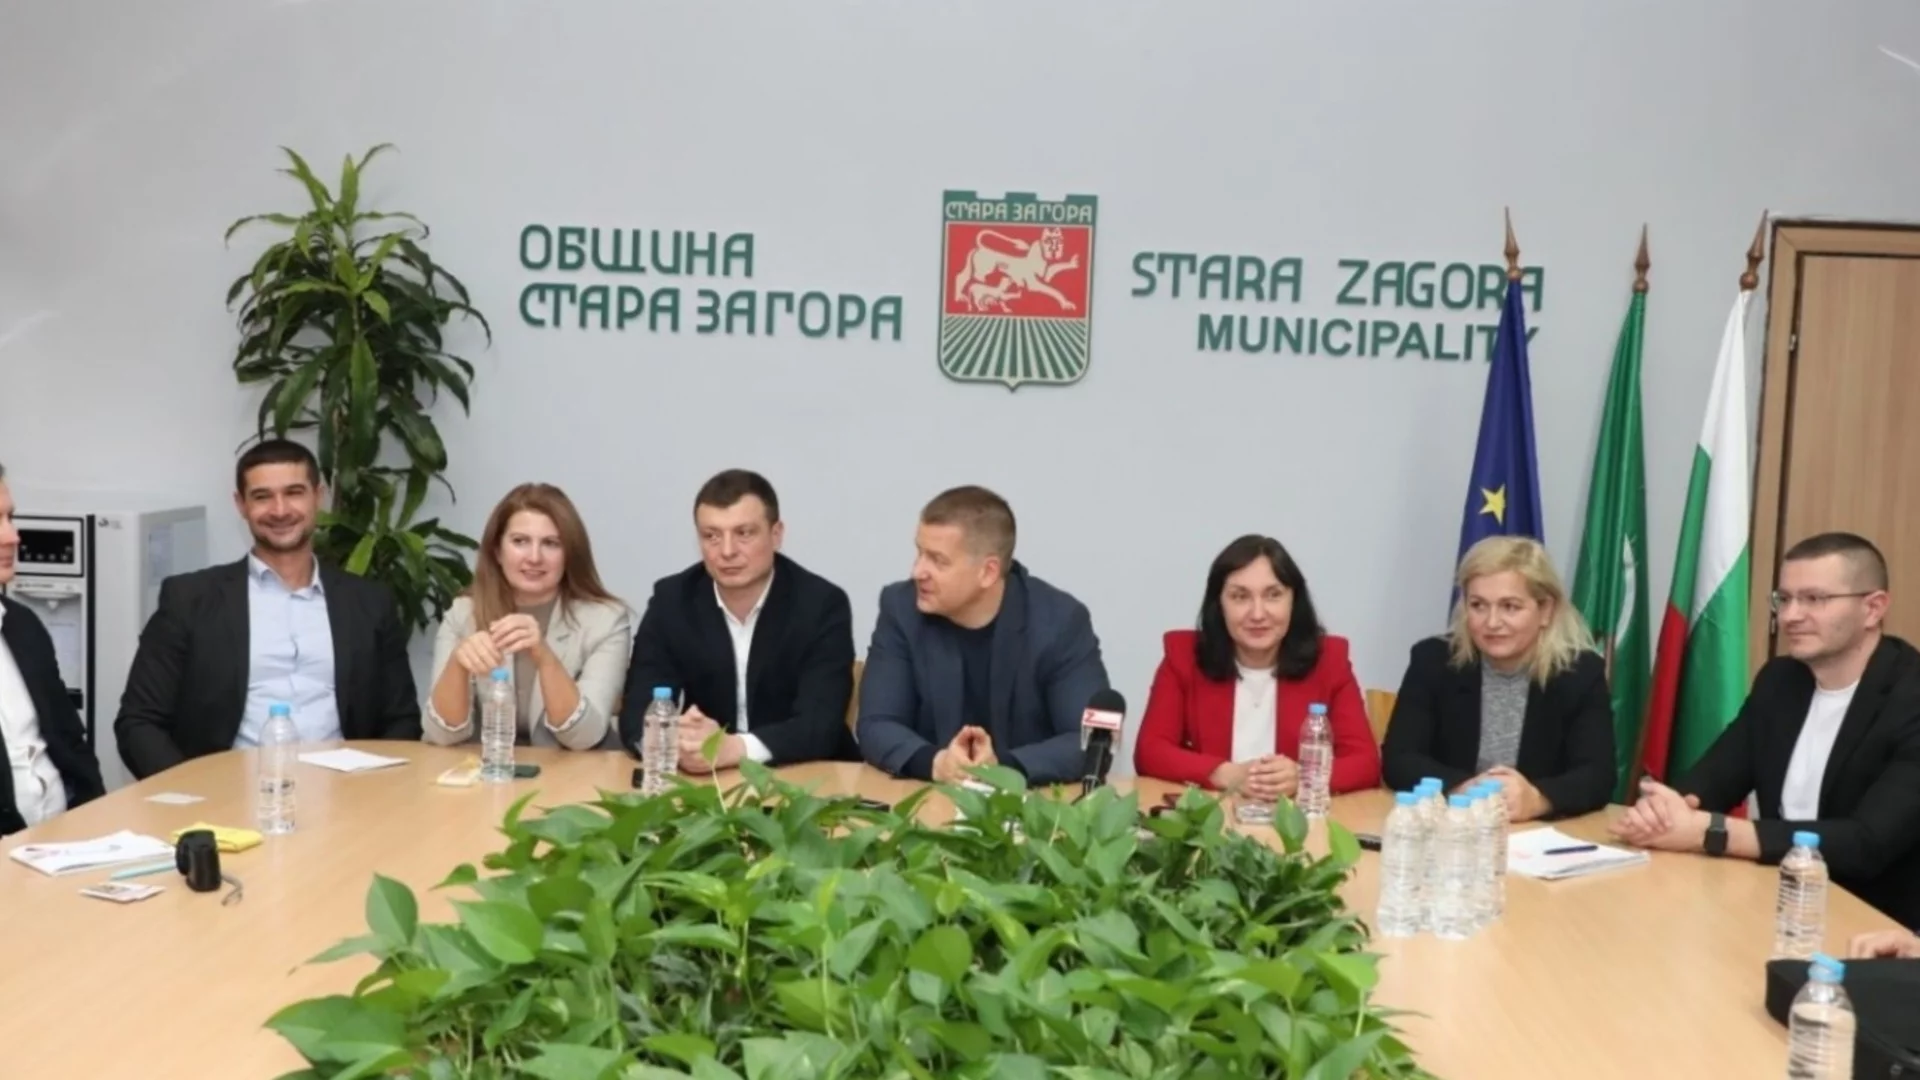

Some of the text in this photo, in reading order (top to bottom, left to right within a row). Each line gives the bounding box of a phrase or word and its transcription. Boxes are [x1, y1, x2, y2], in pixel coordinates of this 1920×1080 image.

[945, 201, 1092, 223] СТАРА ЗАГОРА
[519, 224, 754, 278] ОБЩИНА
[1131, 251, 1544, 312] STARA ZAGORA
[519, 282, 903, 341] СТАРА ЗАГОРА
